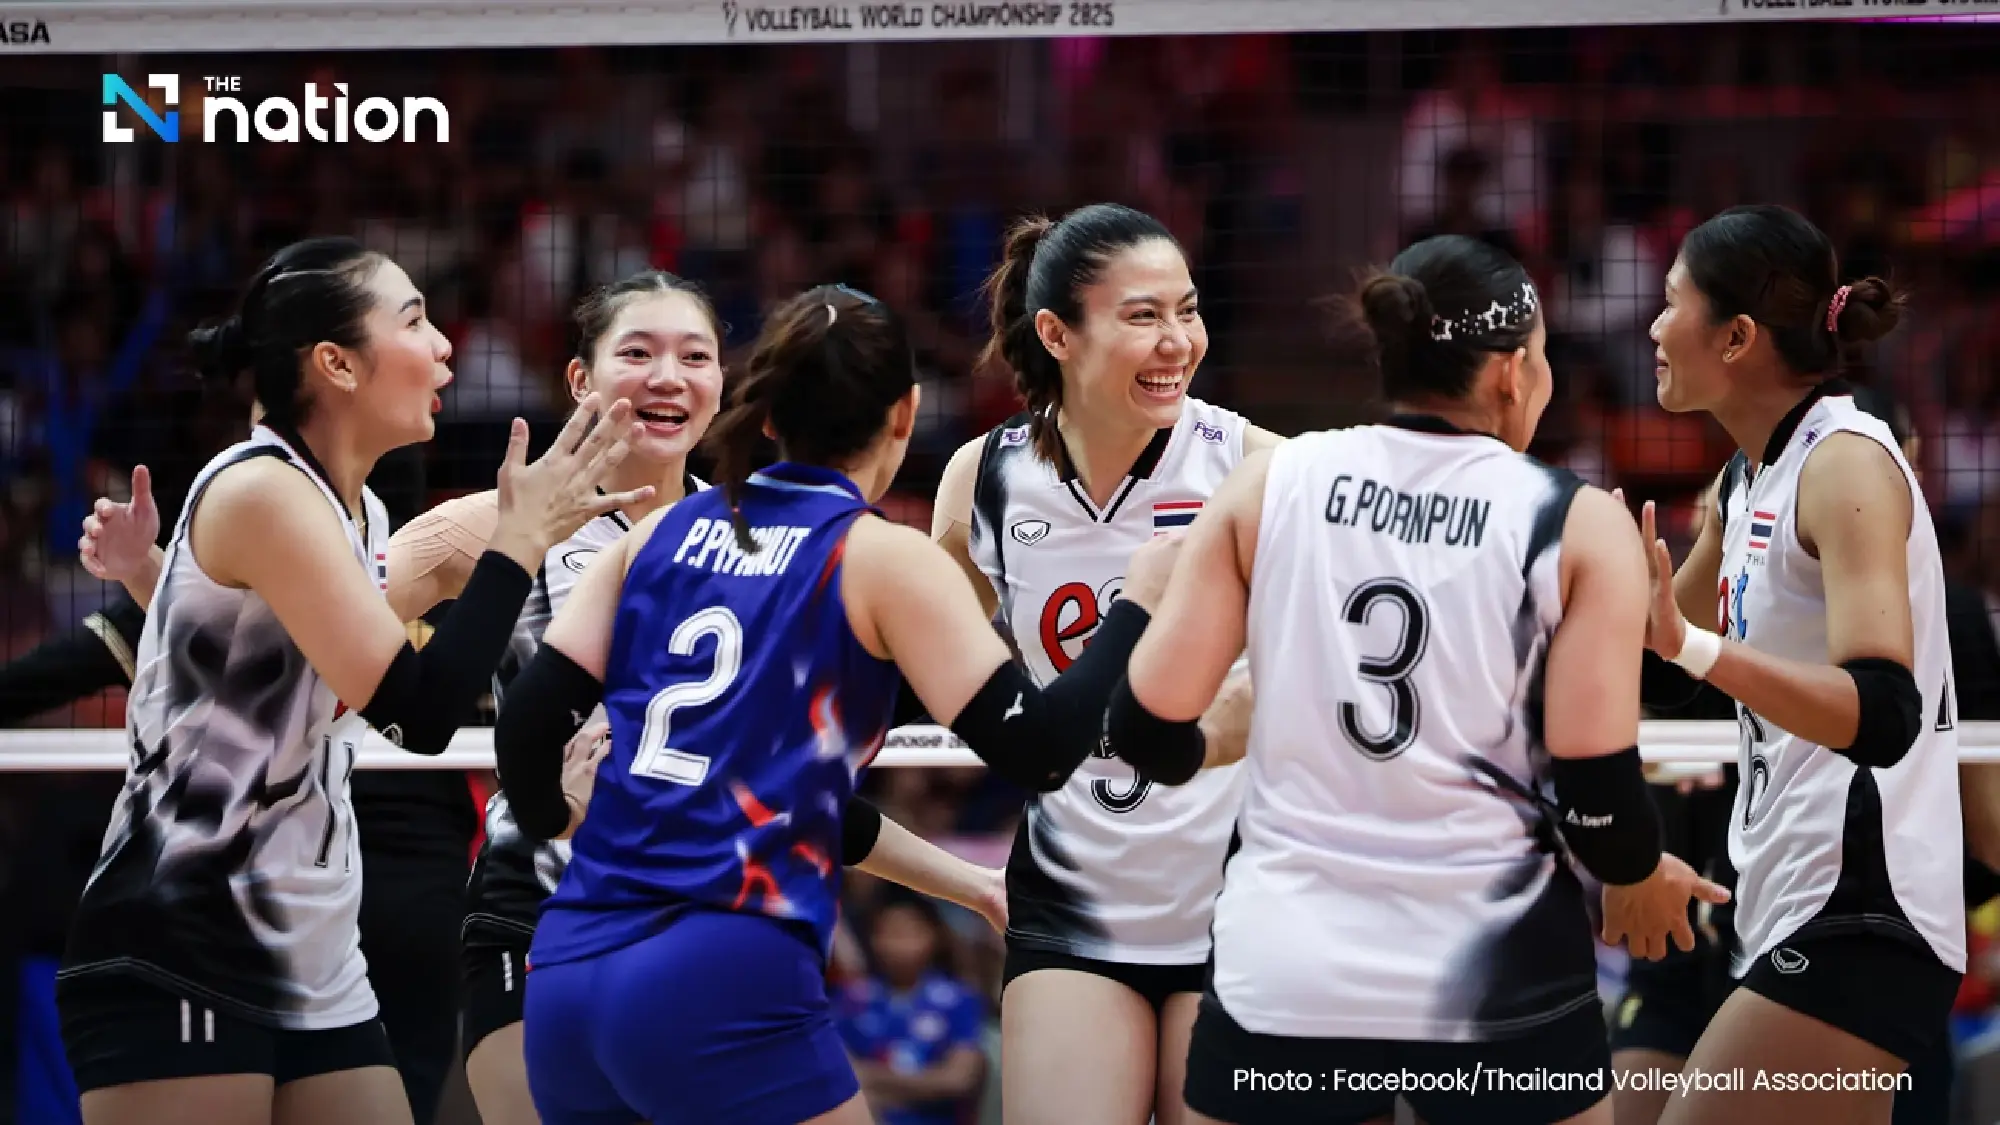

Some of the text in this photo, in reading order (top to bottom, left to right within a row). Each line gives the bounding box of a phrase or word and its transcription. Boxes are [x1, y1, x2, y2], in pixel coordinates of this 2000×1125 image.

[745, 6, 852, 31] VOLLEYBALL
[859, 5, 923, 28] WORLD
[931, 2, 1062, 27] CHAMPIONSHIP
[1325, 474, 1491, 548] G.PORNPUN
[629, 605, 743, 787] 2
[1336, 576, 1431, 762] 3
